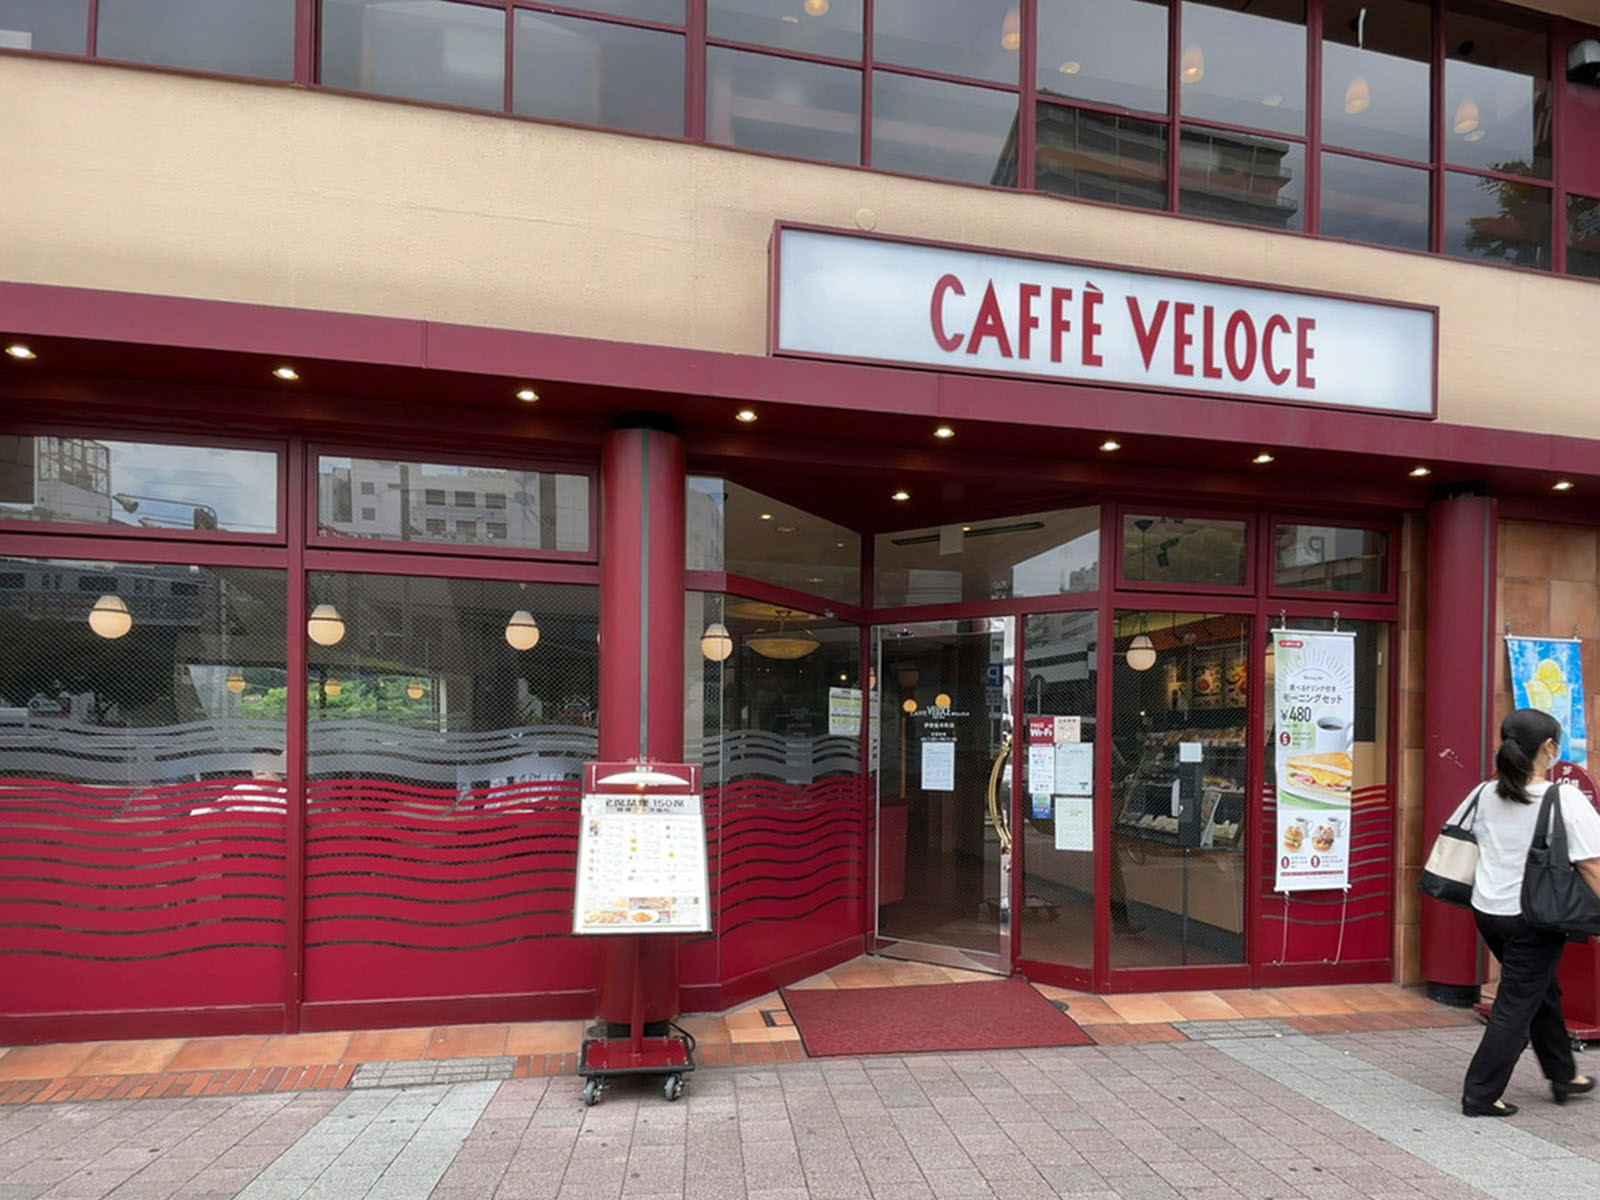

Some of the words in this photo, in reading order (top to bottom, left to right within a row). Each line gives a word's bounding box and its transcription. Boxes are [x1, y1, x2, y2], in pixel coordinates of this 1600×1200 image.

[930, 273, 1104, 367] CAFFÈ
[1125, 295, 1316, 389] VELOCE
[1284, 694, 1343, 704] モーニングセット
[1030, 728, 1052, 737] Wi-Fi
